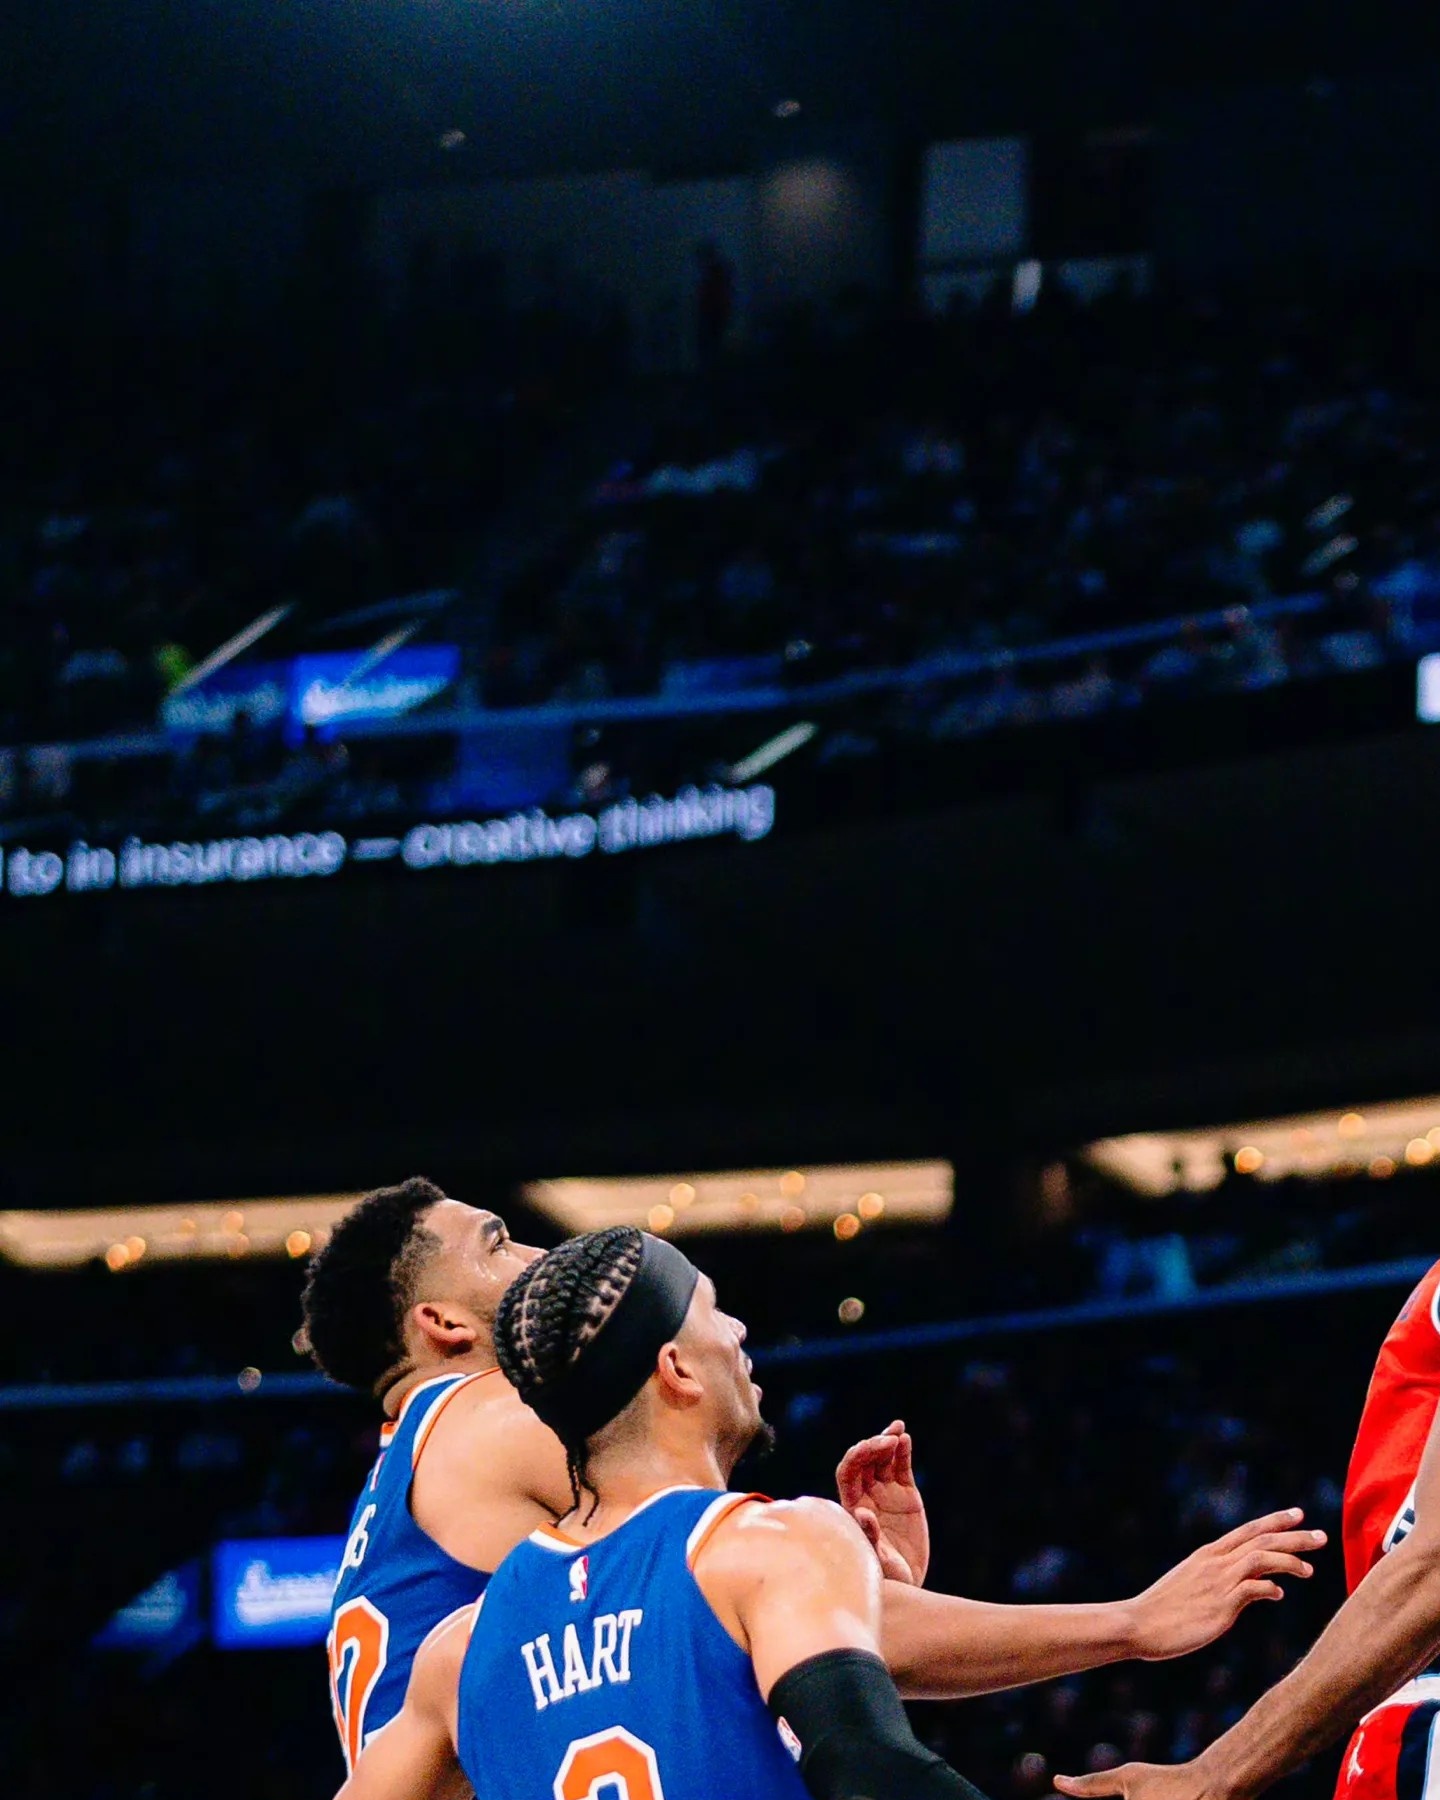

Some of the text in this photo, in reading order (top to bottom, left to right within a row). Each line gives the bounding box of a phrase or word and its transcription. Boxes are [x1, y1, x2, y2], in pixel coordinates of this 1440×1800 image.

[8, 847, 63, 896] to
[66, 841, 116, 892] in
[120, 834, 346, 888] insurance
[402, 806, 597, 869] creative
[600, 784, 775, 854] thinking
[521, 1608, 643, 1711] HART
